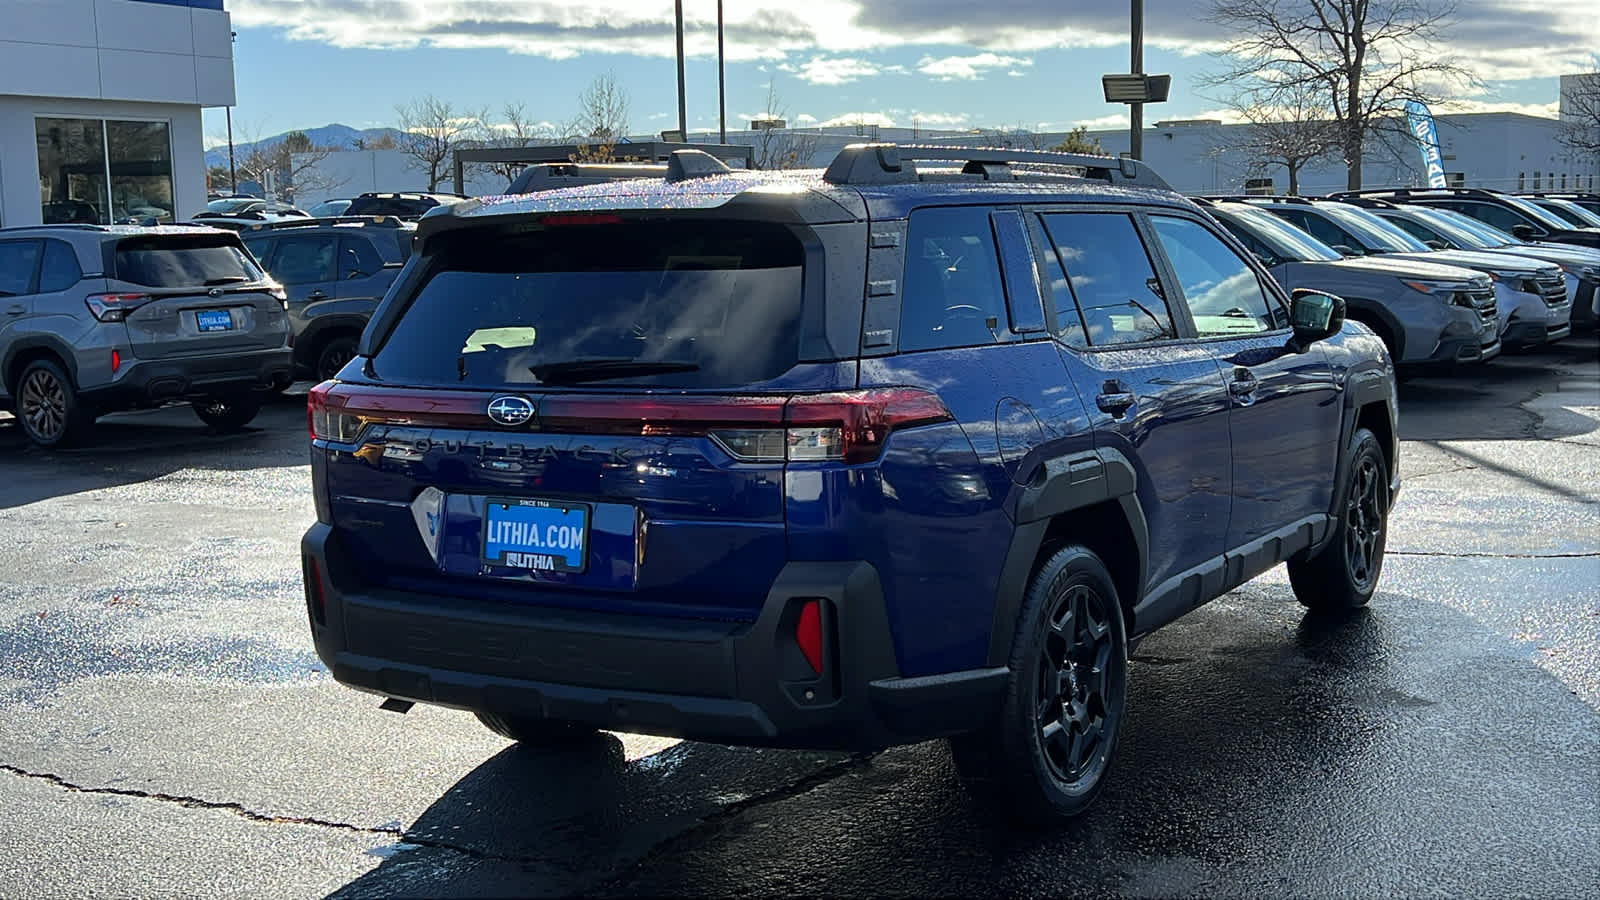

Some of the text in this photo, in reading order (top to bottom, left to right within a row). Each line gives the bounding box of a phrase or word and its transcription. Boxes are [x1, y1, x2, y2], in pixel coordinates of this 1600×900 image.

[1414, 120, 1446, 188] SUBAR
[412, 438, 631, 463] OUTBACK
[518, 499, 536, 507] SINCE
[487, 520, 583, 549] LITHIA.COM
[517, 553, 554, 570] LITHIA
